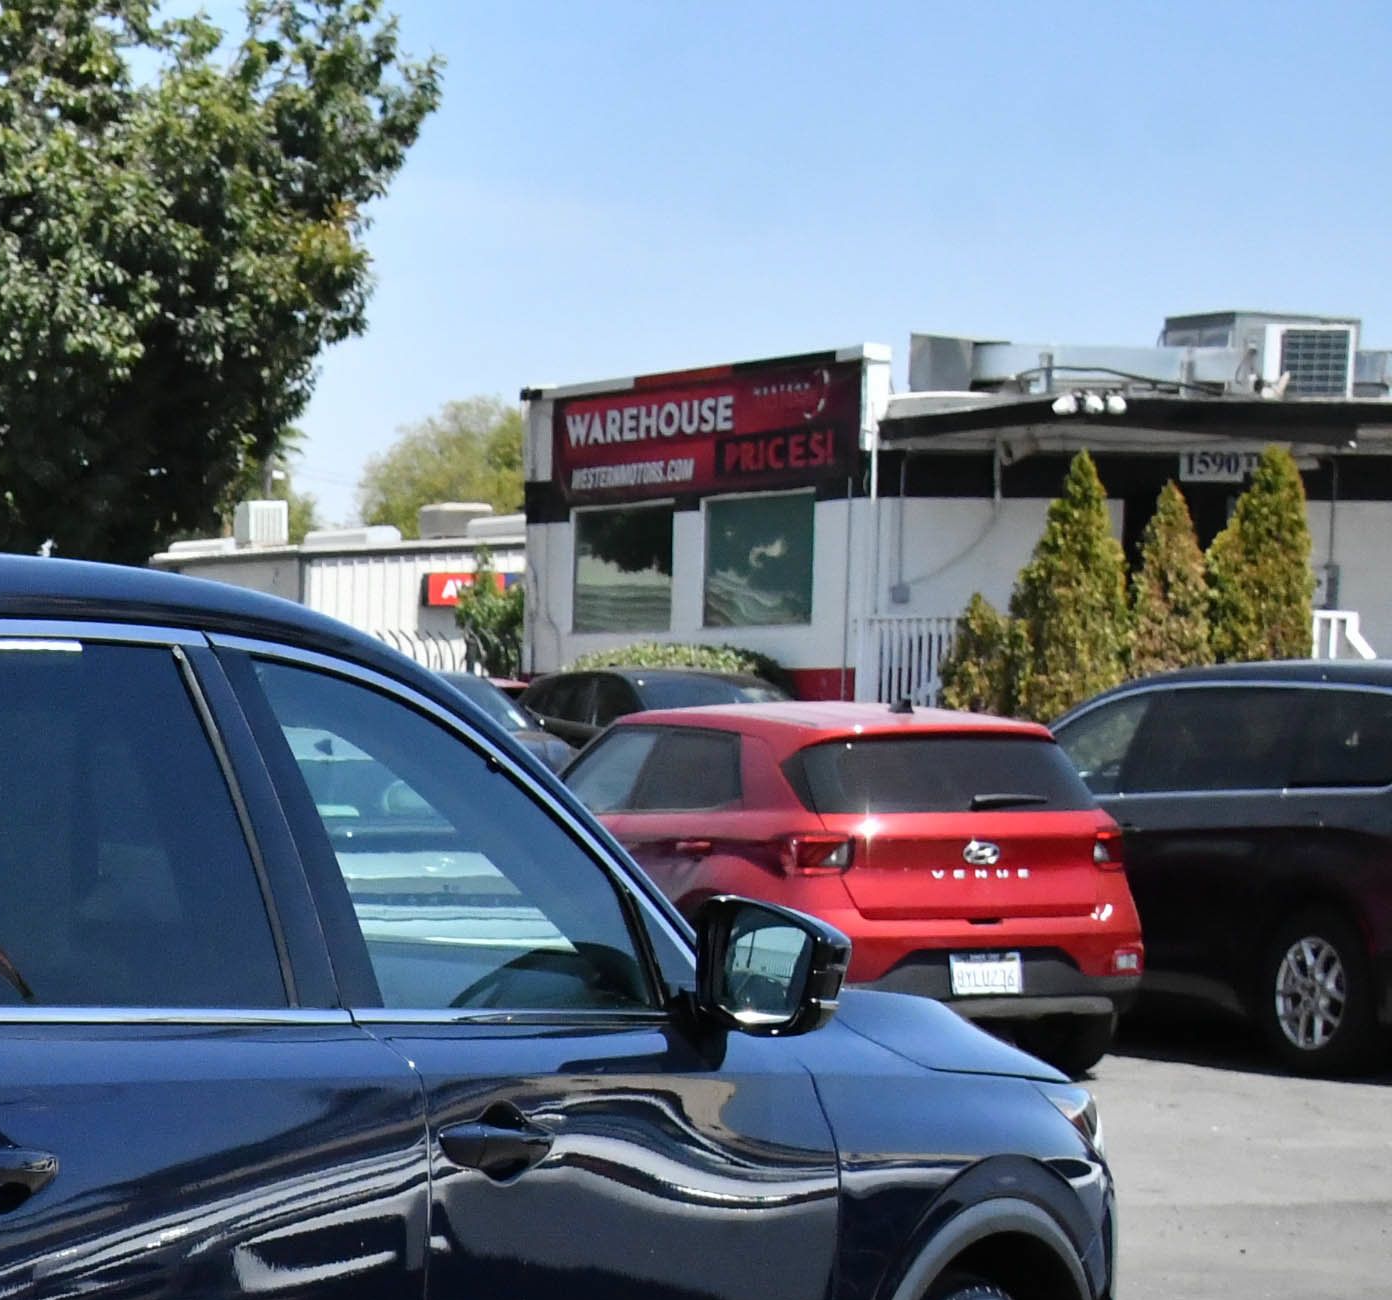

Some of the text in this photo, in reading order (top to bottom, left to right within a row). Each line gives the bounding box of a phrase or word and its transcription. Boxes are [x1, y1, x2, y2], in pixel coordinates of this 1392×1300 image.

[565, 396, 734, 448] WAREHOUSE
[723, 429, 835, 473] PRICES!
[931, 869, 1030, 880] VENUE
